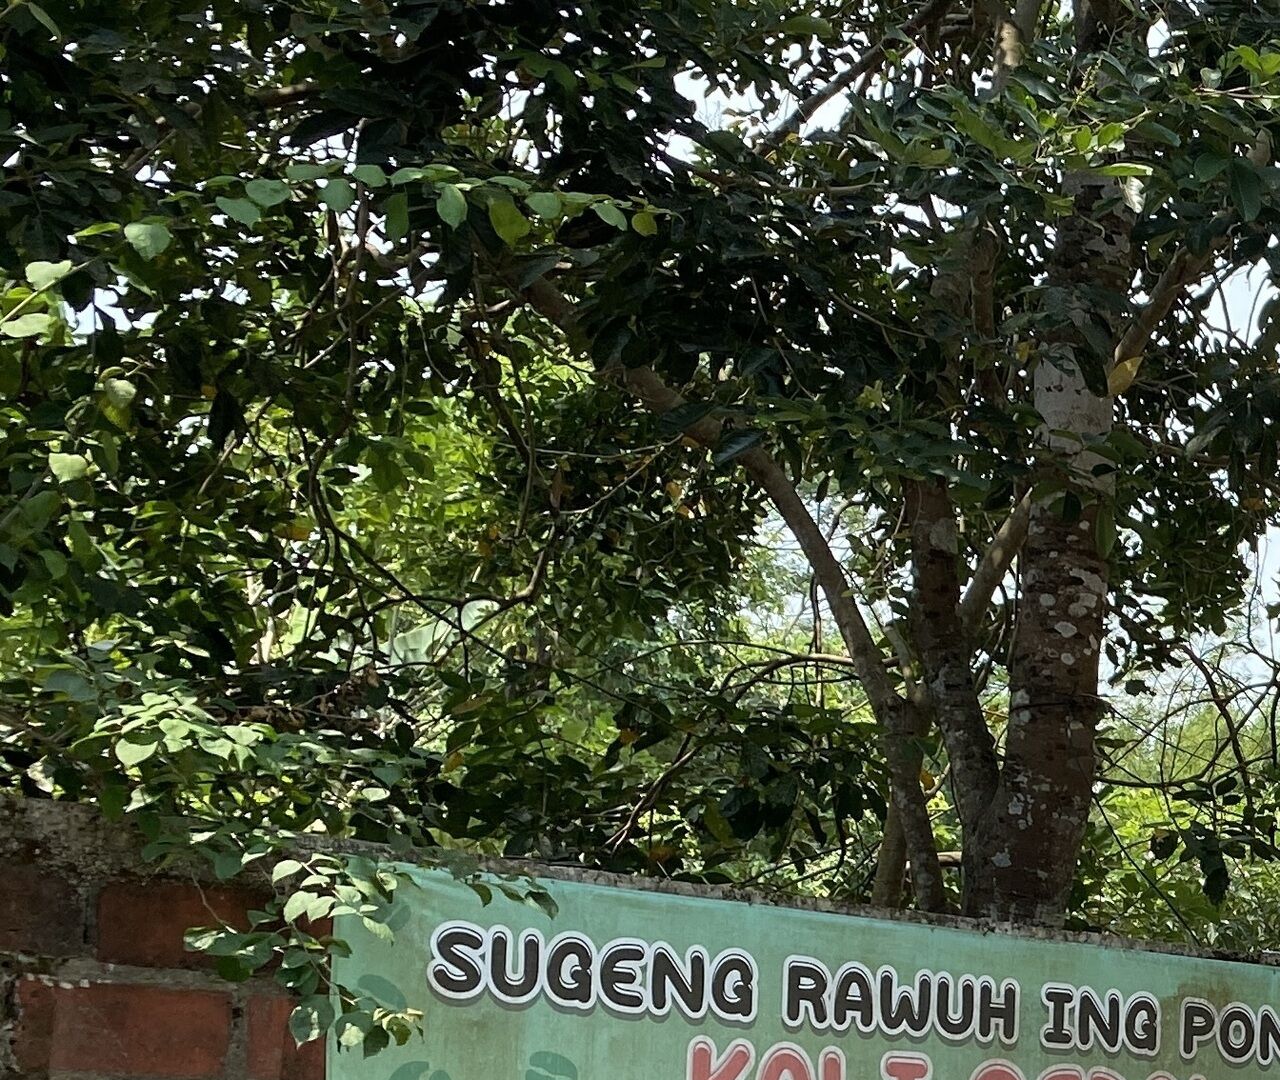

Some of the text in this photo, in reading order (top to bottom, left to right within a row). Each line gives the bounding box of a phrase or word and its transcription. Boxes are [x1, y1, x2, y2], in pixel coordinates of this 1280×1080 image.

[431, 923, 756, 1020] SUGENG
[786, 958, 1018, 1038] RAWUH
[1042, 985, 1159, 1053] ING
